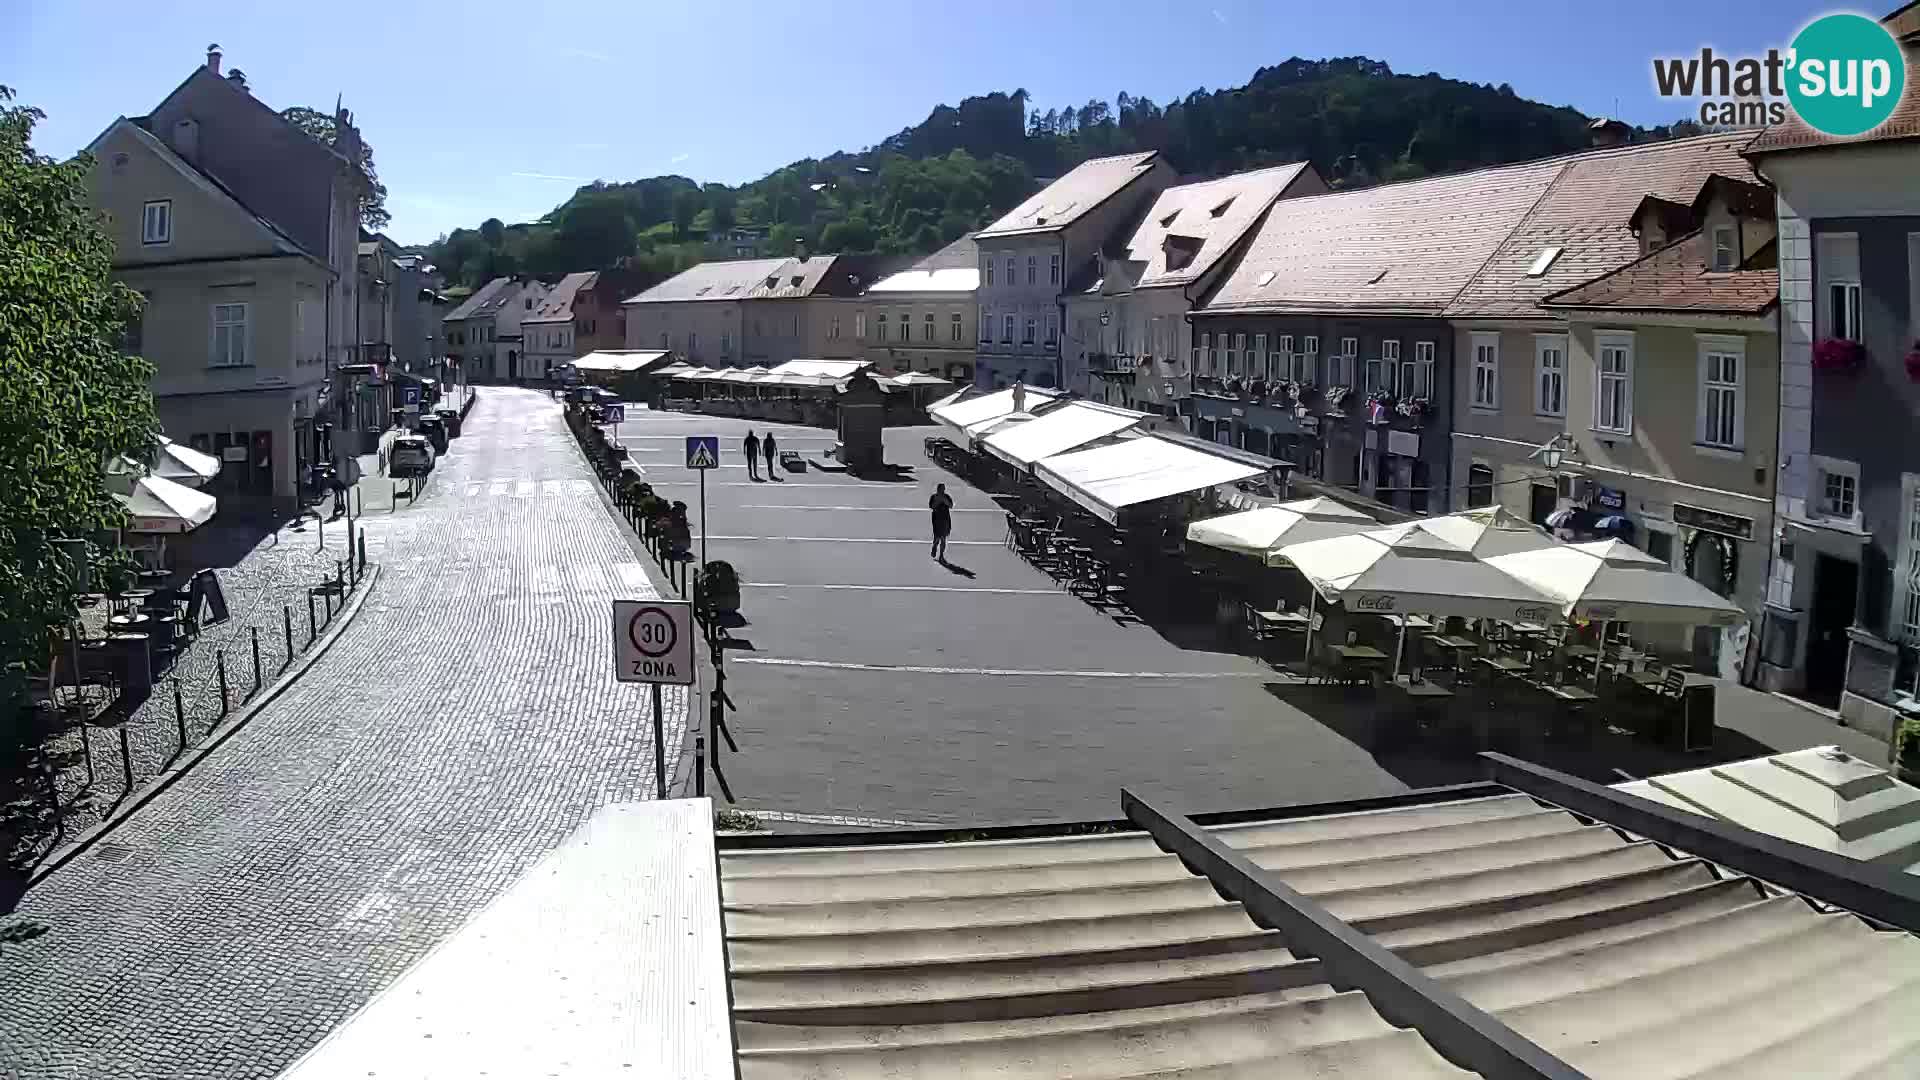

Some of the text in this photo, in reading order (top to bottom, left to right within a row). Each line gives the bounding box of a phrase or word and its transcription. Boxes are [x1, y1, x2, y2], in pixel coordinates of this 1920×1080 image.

[407, 391, 416, 403] P
[641, 623, 665, 644] 30
[631, 660, 676, 677] ZONA
